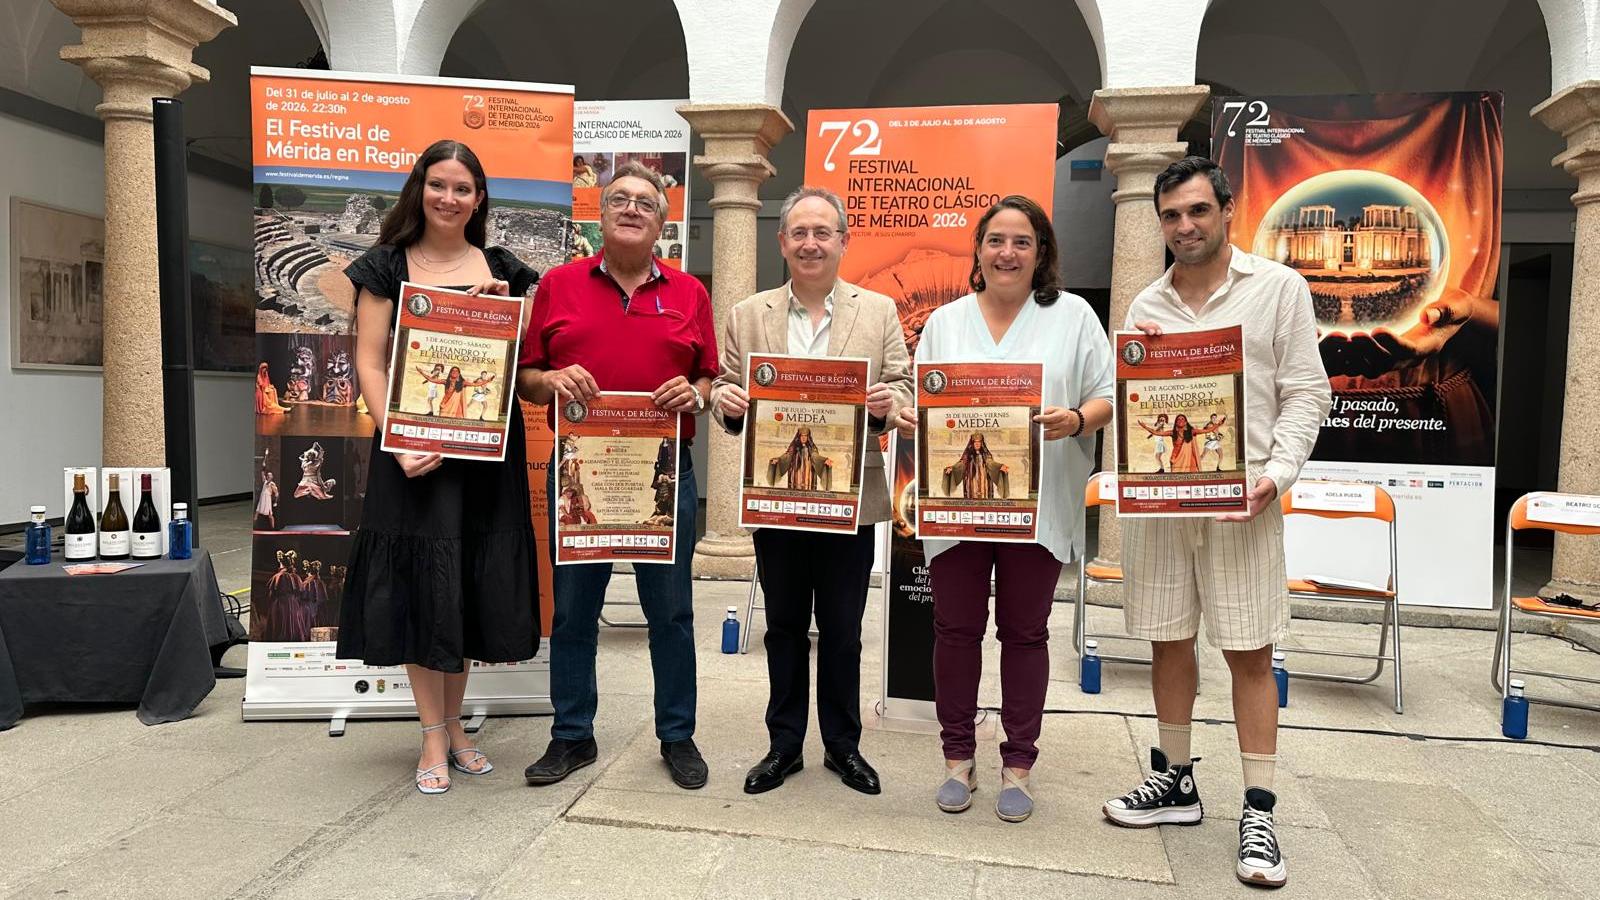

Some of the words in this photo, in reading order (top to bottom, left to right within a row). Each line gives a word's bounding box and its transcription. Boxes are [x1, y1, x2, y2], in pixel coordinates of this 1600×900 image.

[266, 87, 282, 97] Del
[286, 88, 297, 98] 31
[301, 89, 314, 99] de
[316, 91, 338, 102] julio
[340, 92, 350, 101] al
[352, 92, 359, 102] 2
[361, 93, 374, 103] de
[376, 95, 410, 105] agosto
[488, 97, 518, 105] FESTIVAL
[266, 101, 278, 111] de
[281, 102, 309, 113] 2026.
[312, 103, 346, 115] 22:30h
[463, 95, 485, 111] 72
[488, 105, 543, 114] INTERNACIONAL
[499, 113, 524, 121] TEATRO
[920, 119, 941, 127] JULIO
[975, 117, 1007, 125] AGOSTO
[1223, 100, 1271, 137] 72
[266, 118, 283, 136] El
[289, 119, 362, 140] Festival
[367, 125, 390, 142] de
[578, 120, 642, 129] INTERNACIONAL
[584, 129, 618, 139] CLÁSICO
[619, 130, 630, 138] DE
[631, 128, 662, 139] MÉRIDA
[664, 129, 682, 138] 2026
[818, 119, 882, 172] 72
[266, 140, 331, 161] Mérida
[336, 149, 359, 162] en
[365, 146, 422, 168] Regin
[849, 159, 918, 174] FESTIVAL
[848, 177, 975, 192] INTERNACIONAL
[847, 195, 869, 210] DE
[872, 195, 929, 210] TEATRO
[933, 191, 1000, 209] CLÁSICO
[847, 214, 866, 227] DE
[870, 210, 929, 228] MÉRIDA
[932, 213, 967, 228] 2026
[436, 306, 470, 317] FESTIVAL
[471, 310, 482, 318] DE
[483, 309, 513, 322] RÉGINA
[429, 345, 480, 357] ALEJANDRO
[482, 350, 488, 358] Y
[1150, 350, 1188, 358] FESTIVAL
[1190, 348, 1201, 356] DE
[1203, 343, 1235, 355] RÉGINA
[431, 350, 470, 362] EUNUCO
[472, 356, 496, 365] PERSA
[780, 373, 813, 382] FESTIVAL
[816, 375, 826, 383] DE
[828, 373, 858, 384] RÉGINA
[951, 378, 985, 386] FESTIVAL
[1000, 376, 1033, 386] RÉGINA
[1148, 391, 1206, 402] ALEJANDRO
[1208, 391, 1214, 399] Y
[1140, 401, 1149, 409] EL
[1152, 400, 1195, 409] EUNUCO
[1198, 398, 1225, 407] PERSA
[1340, 397, 1400, 414] pasado,
[592, 409, 626, 417] FESTIVAL
[627, 410, 638, 418] DE
[639, 408, 669, 418] RÉGINA
[786, 413, 826, 423] MEDEA
[958, 418, 1000, 428] MEDEA
[1353, 414, 1376, 428] del
[1377, 417, 1447, 432] presente.
[912, 566, 930, 575] Clás
[914, 575, 927, 584] del
[908, 592, 921, 601] del
